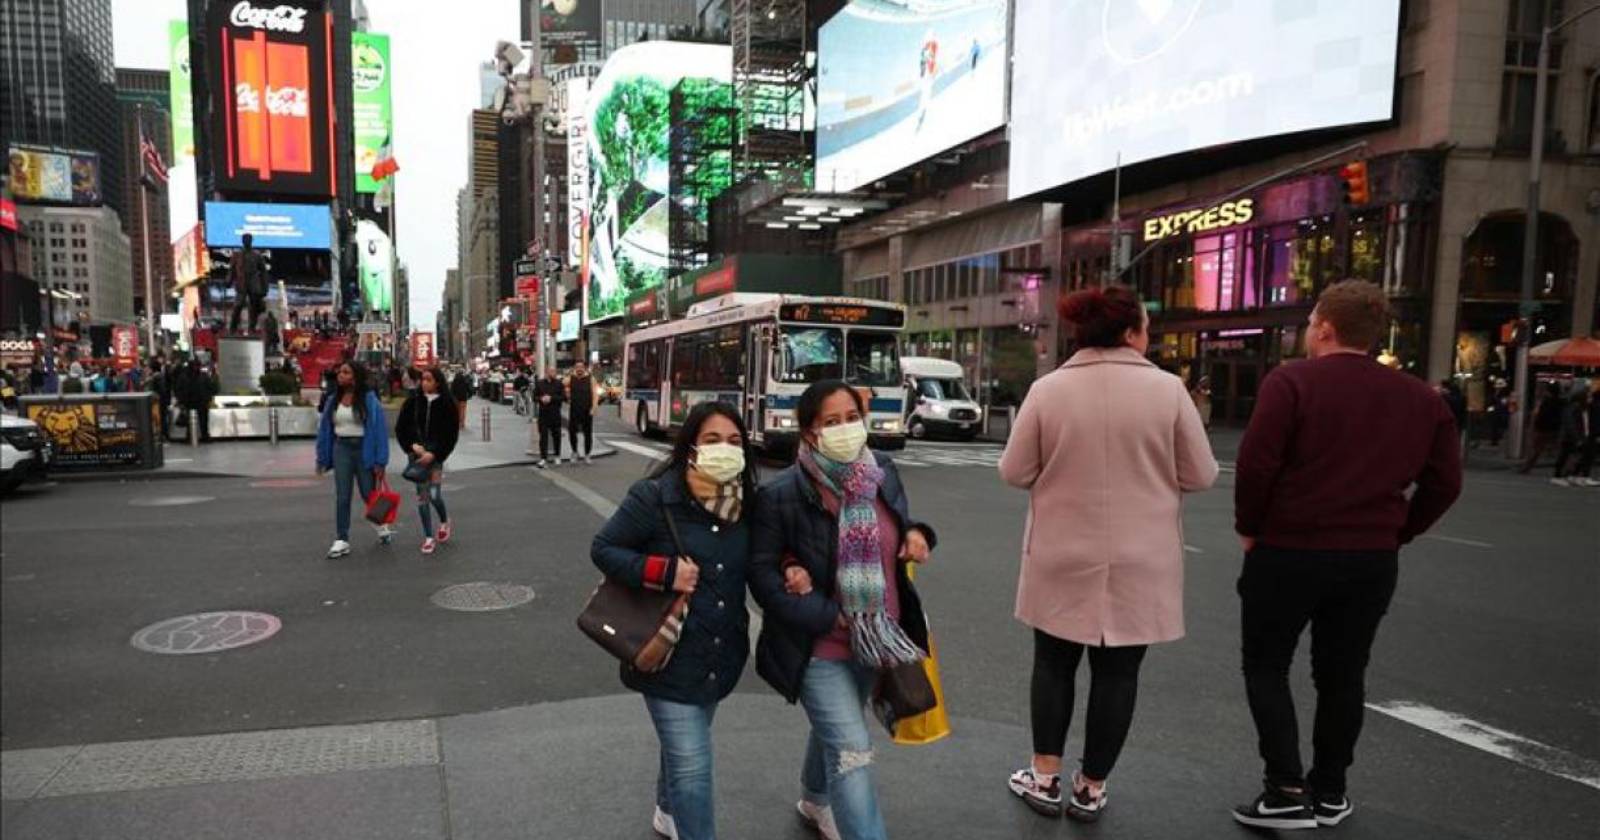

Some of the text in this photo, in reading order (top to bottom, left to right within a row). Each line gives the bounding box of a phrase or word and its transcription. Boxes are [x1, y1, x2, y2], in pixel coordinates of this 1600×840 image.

[551, 63, 585, 86] LITTLE
[1144, 198, 1254, 241] EXPRESS
[0, 339, 35, 350] DOGS
